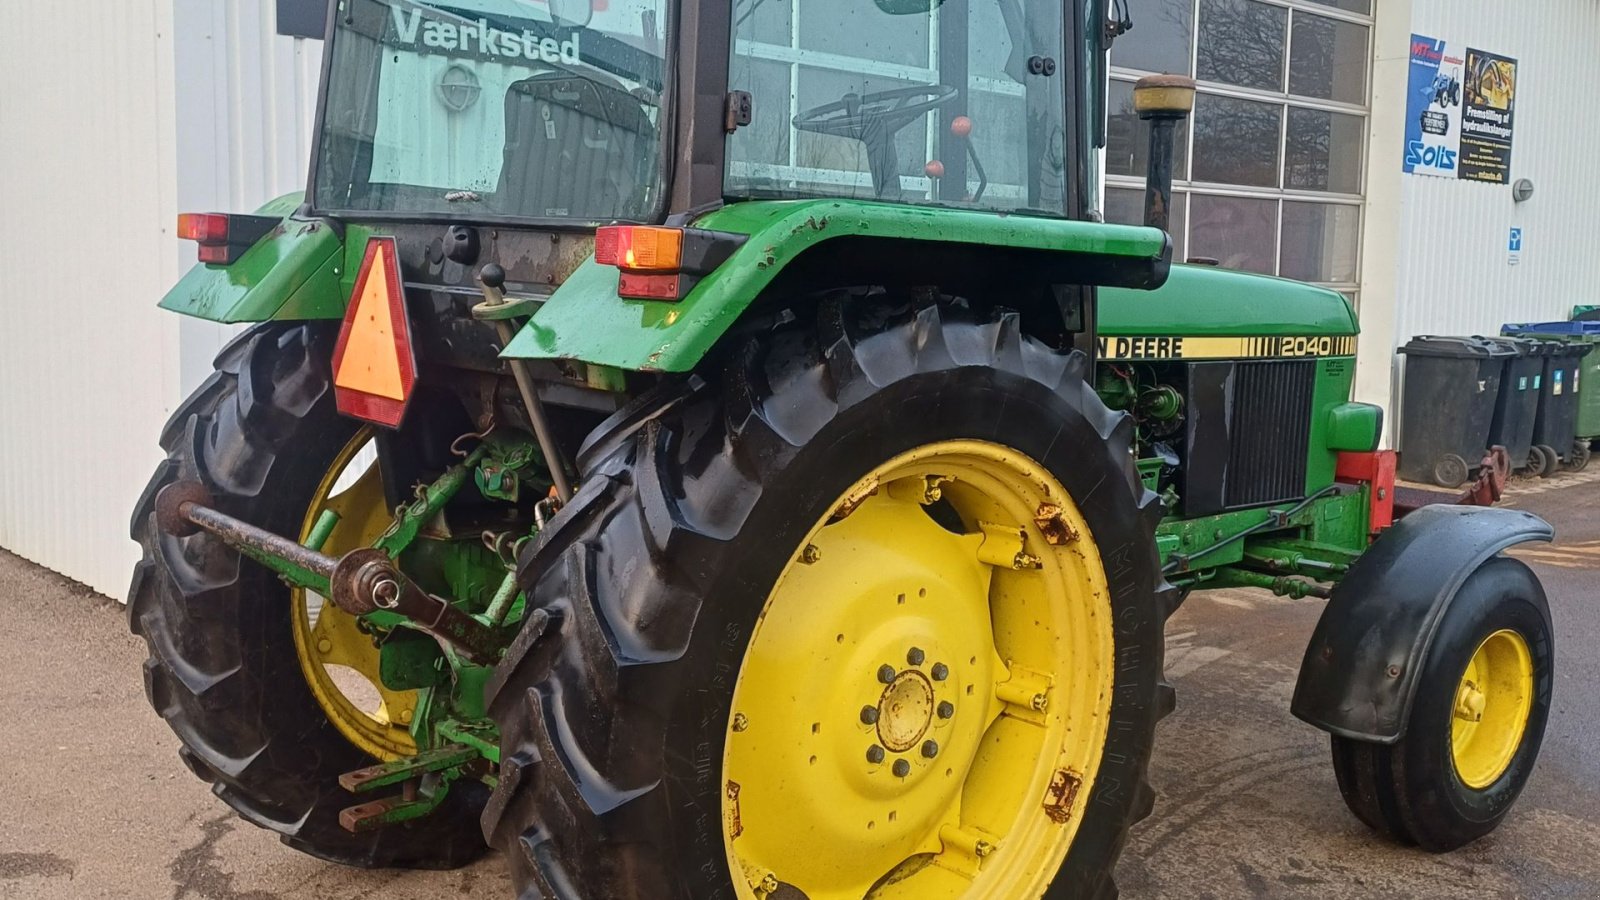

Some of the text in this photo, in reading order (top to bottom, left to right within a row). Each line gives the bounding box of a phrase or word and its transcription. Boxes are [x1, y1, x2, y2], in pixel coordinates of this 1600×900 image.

[391, 5, 580, 66] Værksted
[1467, 105, 1502, 124] Fremstilling
[1406, 140, 1457, 170] Solis
[1115, 337, 1184, 359] DEERE
[1281, 336, 1331, 357] 2040
